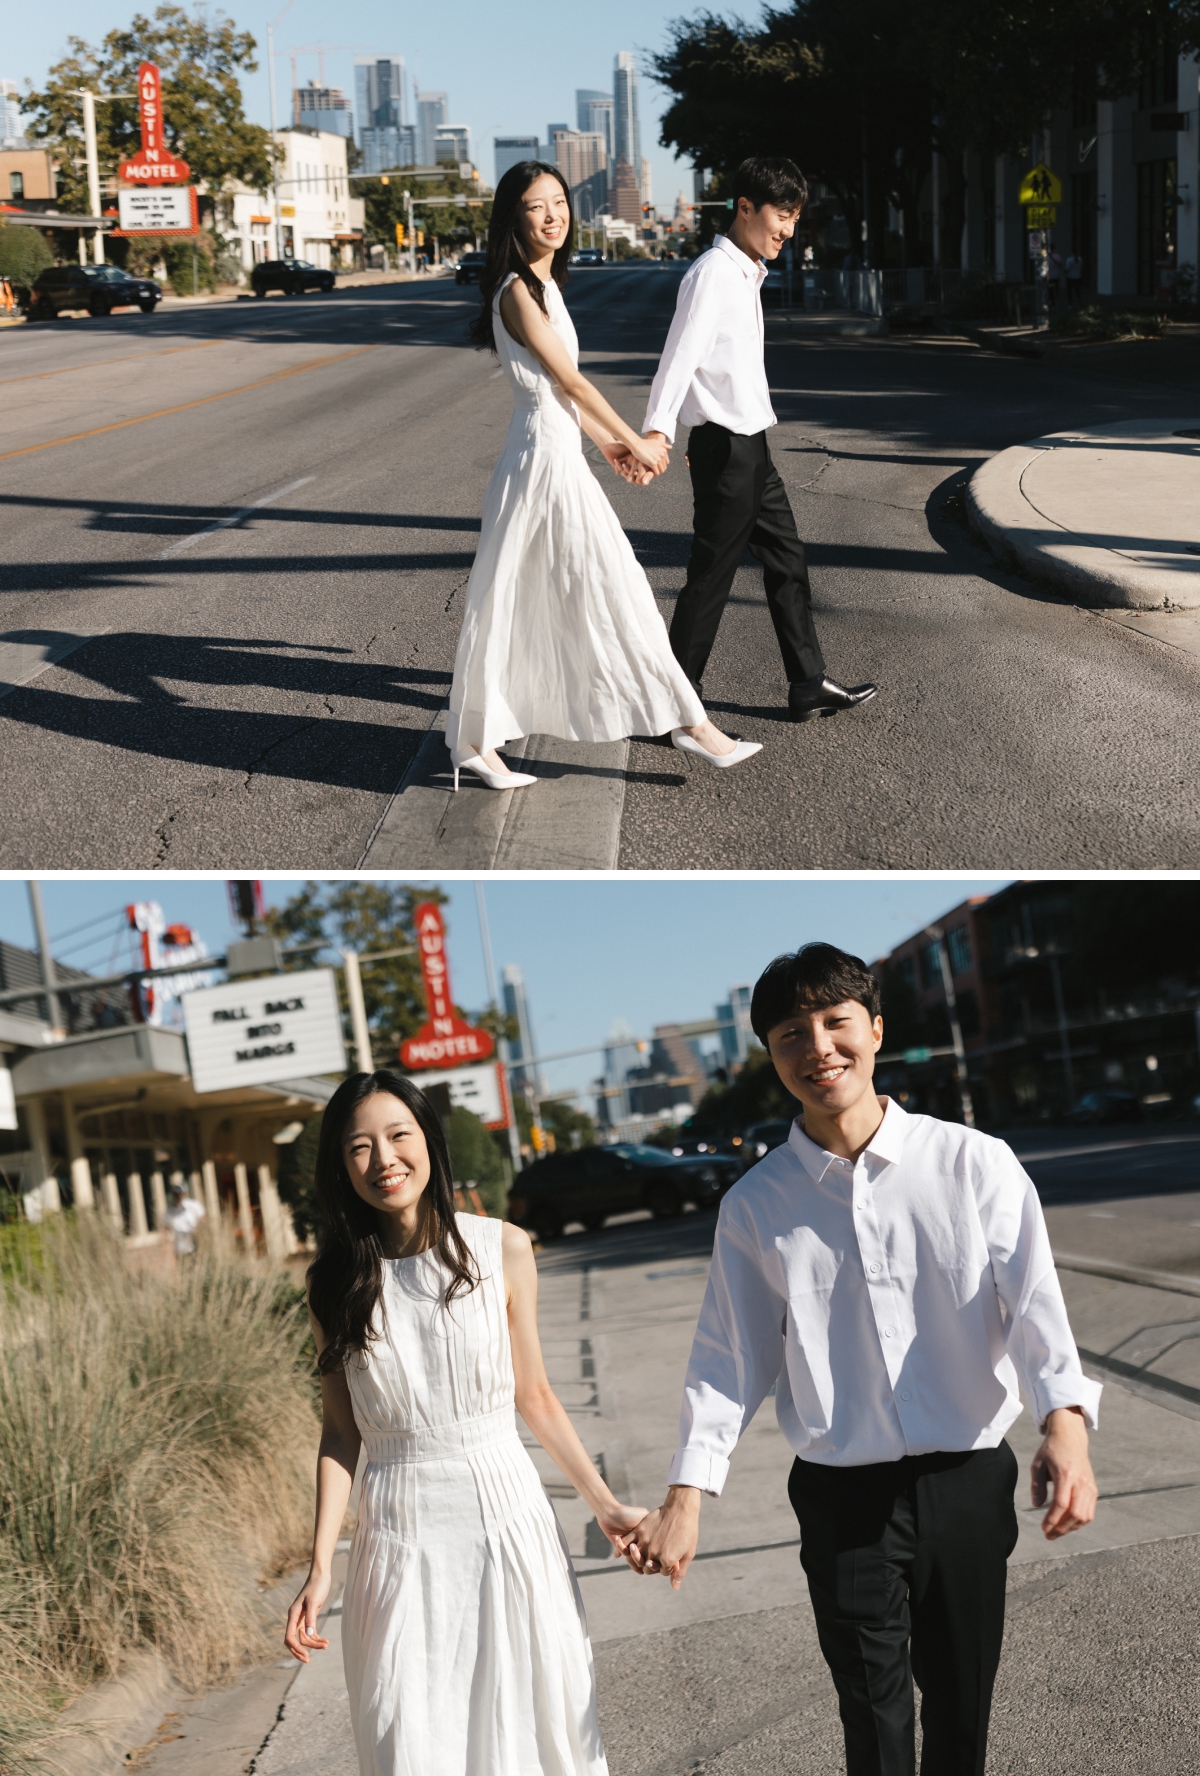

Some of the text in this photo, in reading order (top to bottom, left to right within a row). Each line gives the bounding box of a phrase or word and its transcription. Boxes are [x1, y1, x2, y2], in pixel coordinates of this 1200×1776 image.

[141, 71, 159, 162] AUSTIN
[125, 163, 180, 179] MOTEL
[419, 913, 454, 1037] AUSTIN
[212, 997, 305, 1023] FALL BACK
[247, 1023, 282, 1039] INTO
[235, 1042, 295, 1062] MARGS
[407, 1034, 482, 1064] MOTEL
